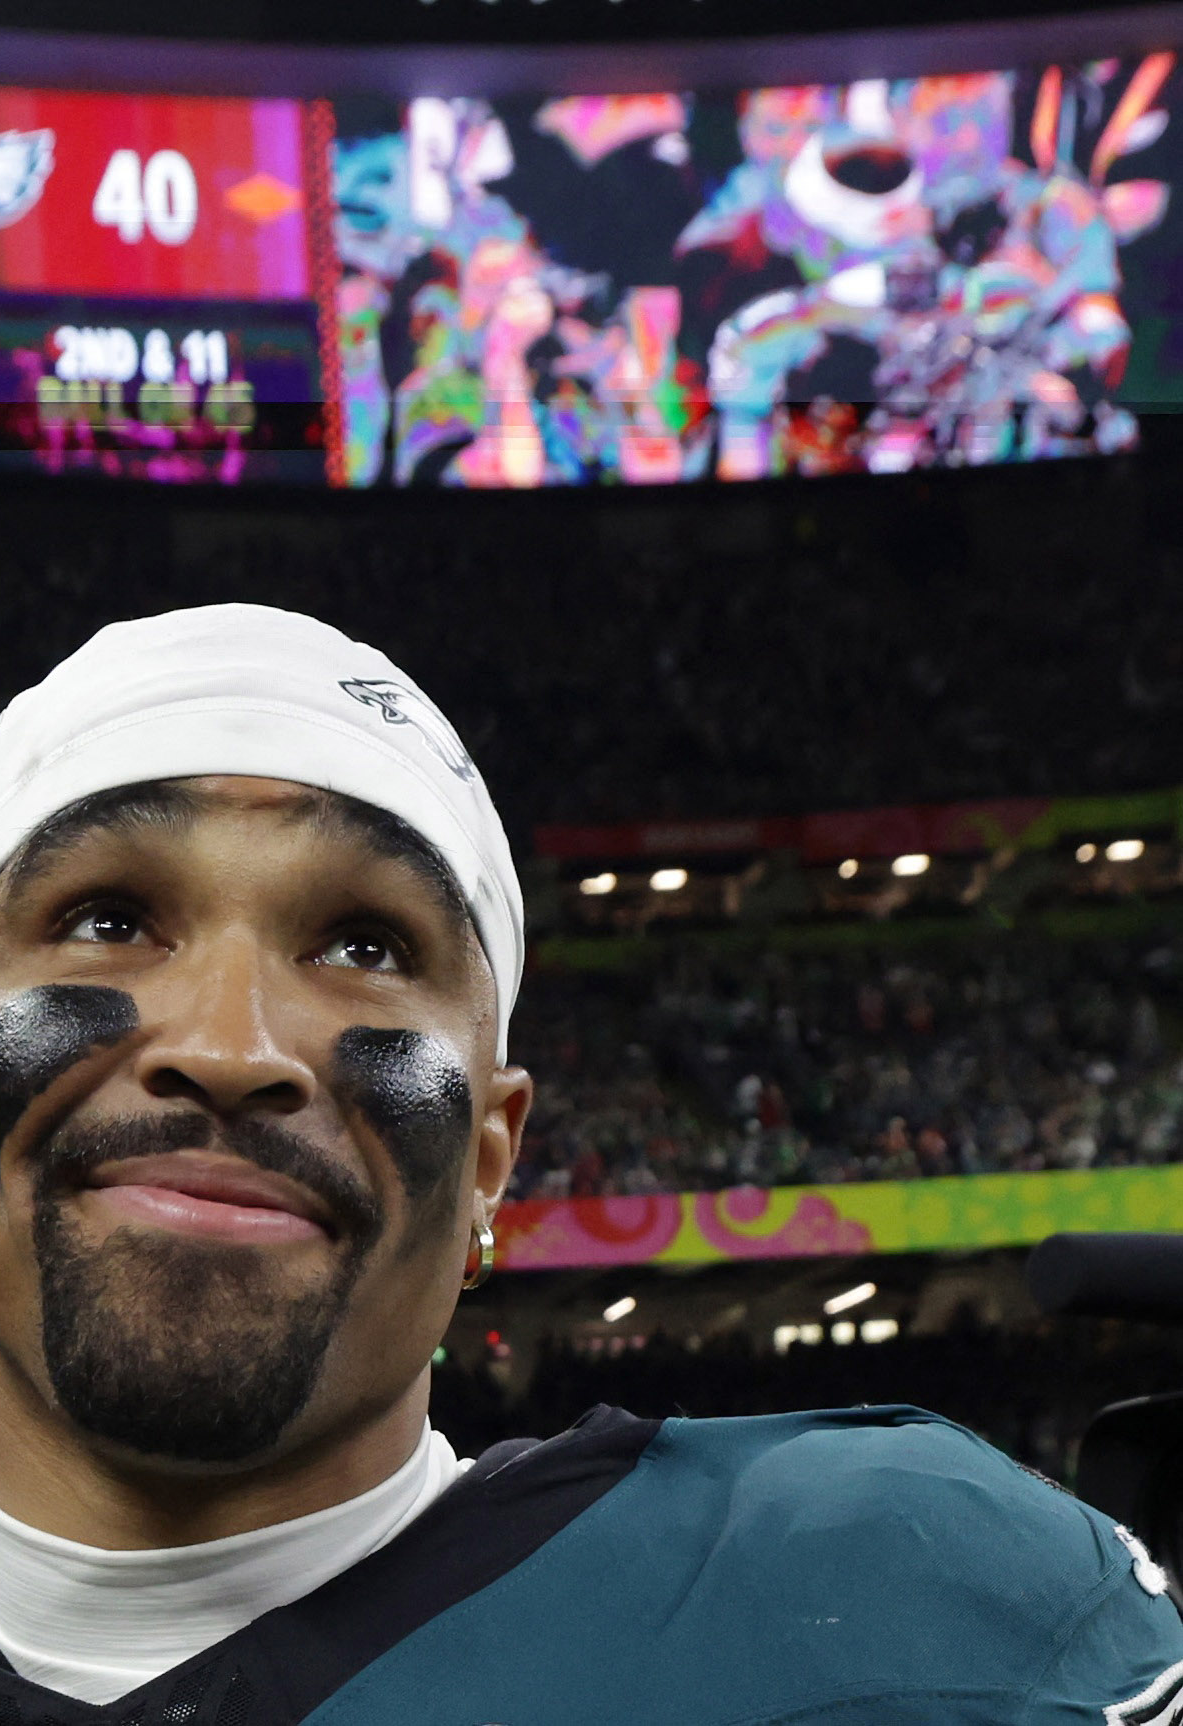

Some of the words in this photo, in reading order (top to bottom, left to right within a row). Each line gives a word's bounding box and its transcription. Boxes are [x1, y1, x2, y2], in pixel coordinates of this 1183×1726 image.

[93, 149, 198, 245] 40
[53, 325, 139, 383] 2ND
[142, 328, 175, 384] &
[180, 329, 229, 386] 11
